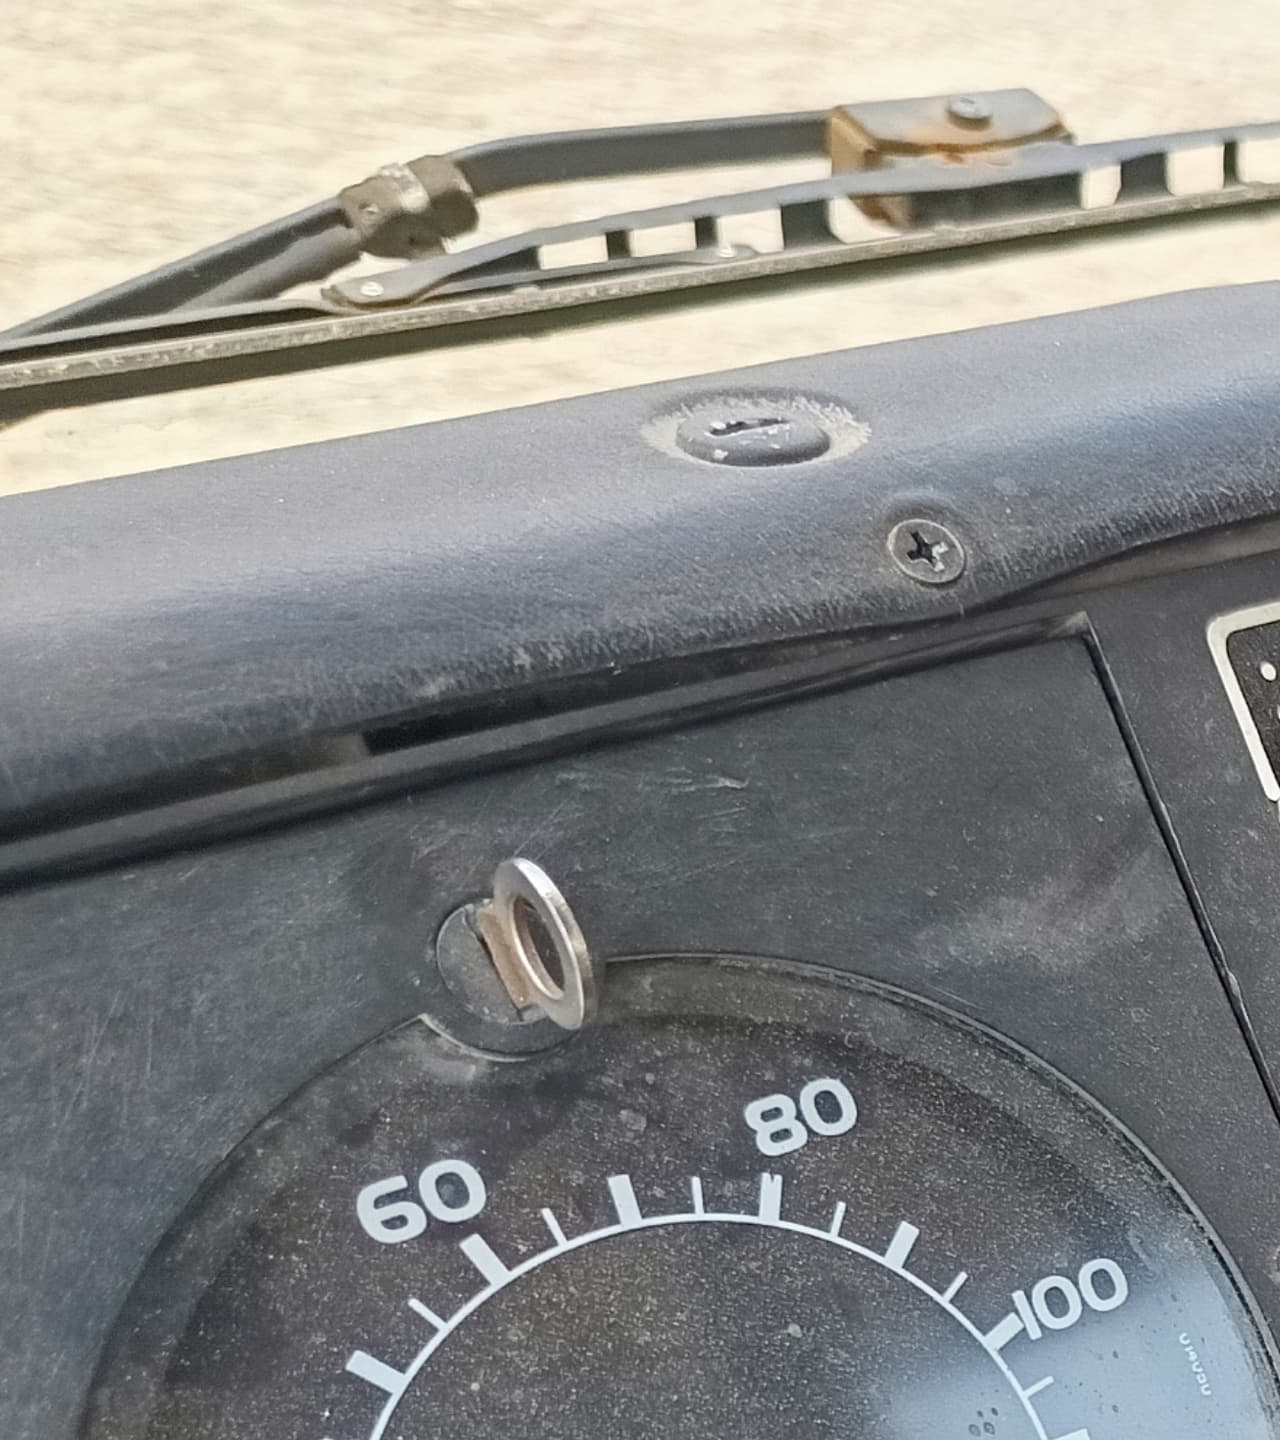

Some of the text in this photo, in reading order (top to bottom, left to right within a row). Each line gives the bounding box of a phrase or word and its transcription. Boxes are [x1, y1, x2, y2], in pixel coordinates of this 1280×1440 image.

[744, 1077, 858, 1157] 80
[356, 1159, 488, 1244] 60
[1011, 1257, 1129, 1341] 100
